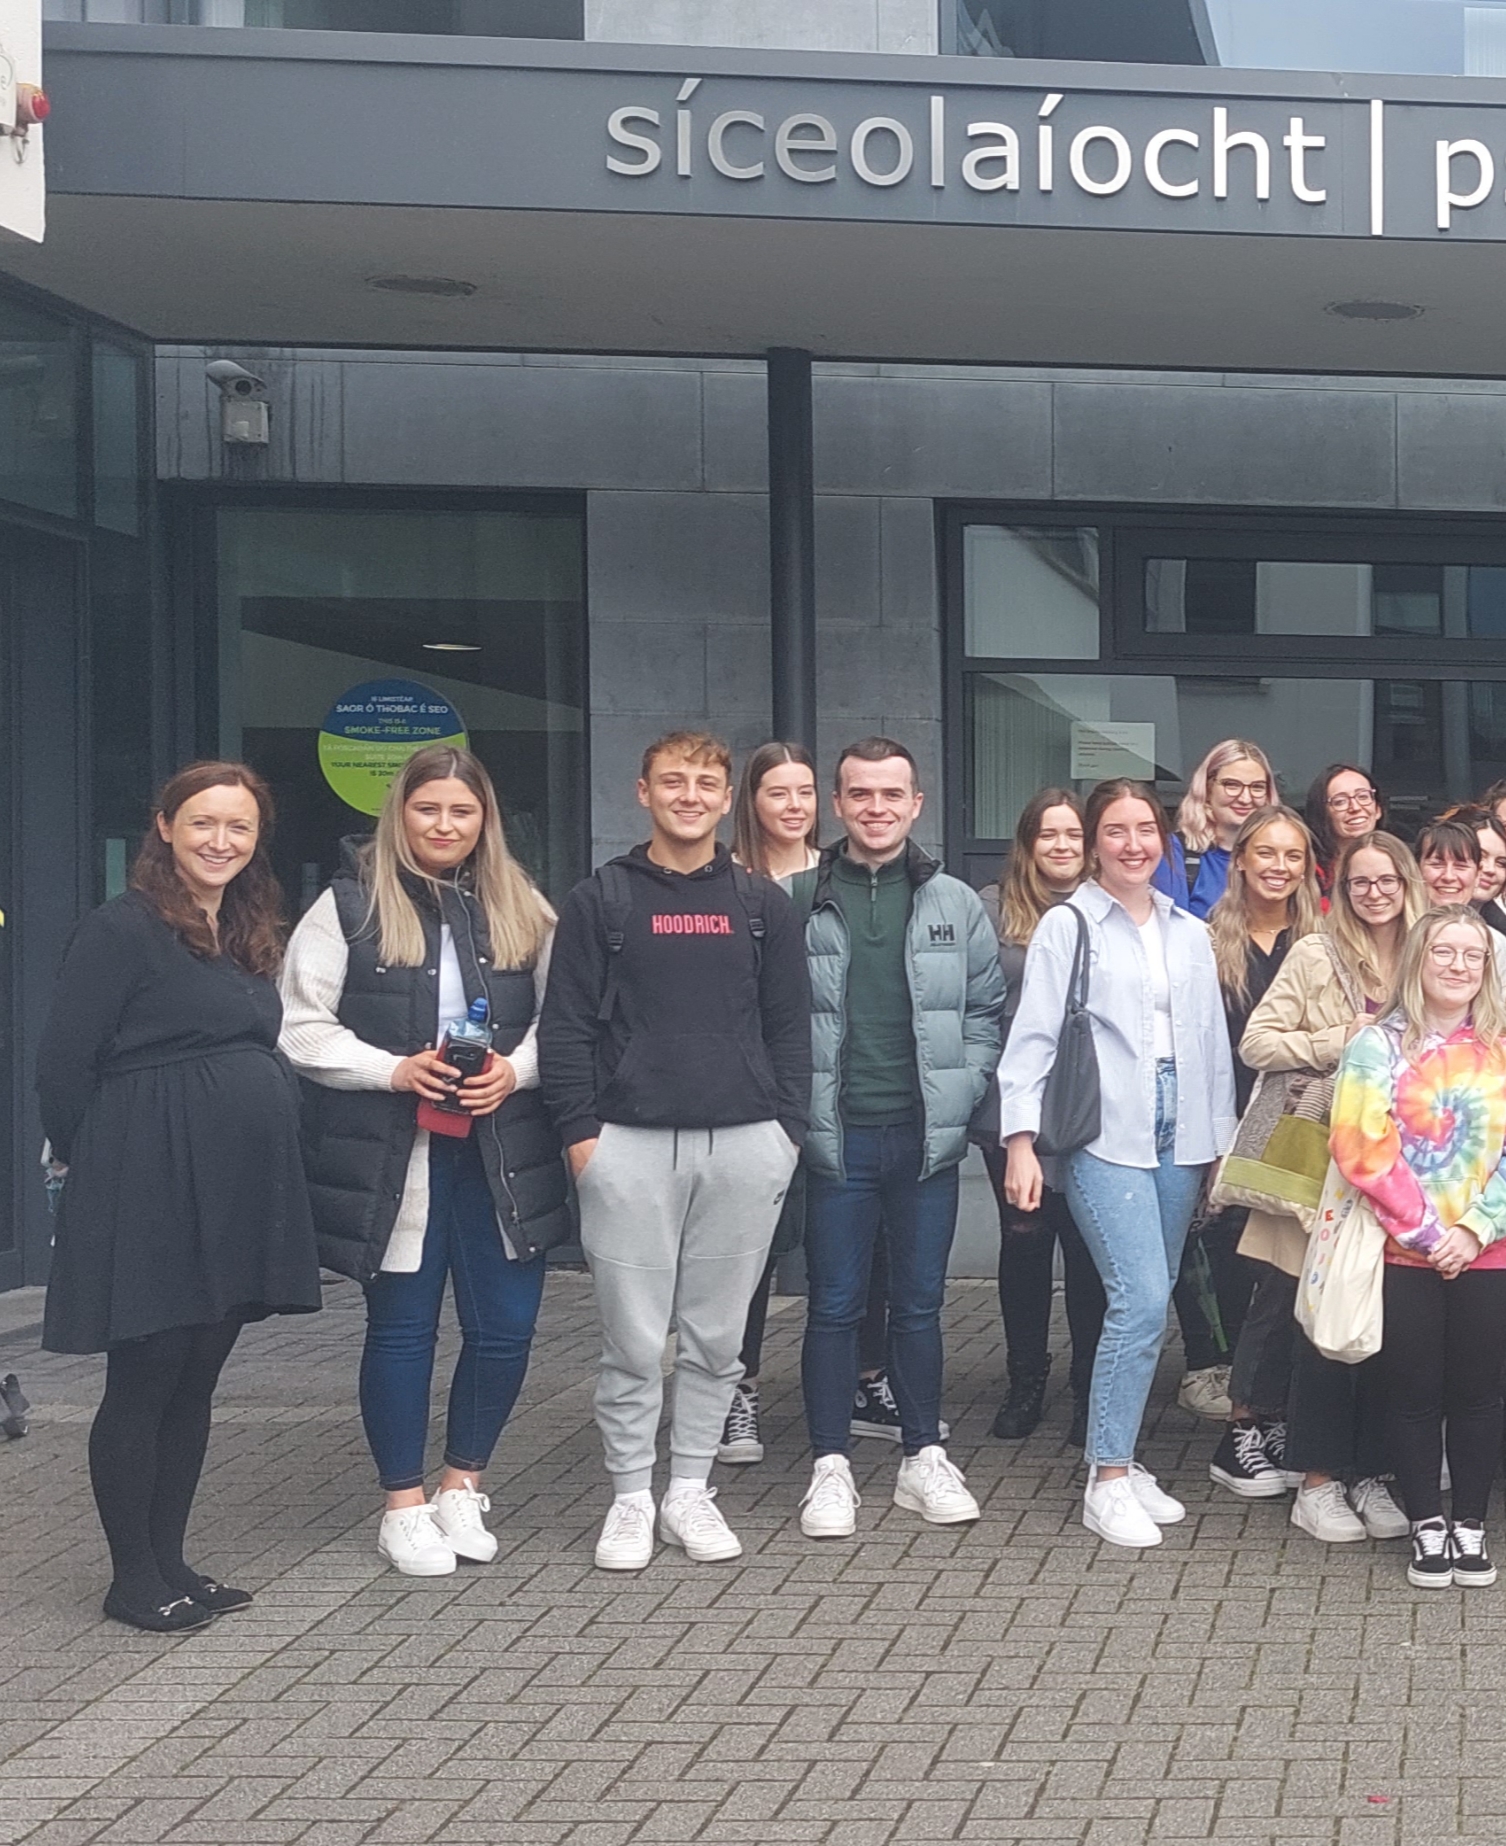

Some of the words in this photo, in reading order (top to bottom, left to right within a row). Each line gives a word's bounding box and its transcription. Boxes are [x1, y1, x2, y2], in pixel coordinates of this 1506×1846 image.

[605, 78, 1327, 203] síceolaíocht
[376, 704, 418, 713] THOBAC
[428, 705, 449, 714] SEO
[344, 725, 410, 734] SMOKE-FREE
[412, 726, 441, 735] ZONE
[652, 914, 730, 934] HOODRICH
[927, 924, 955, 941] HH
